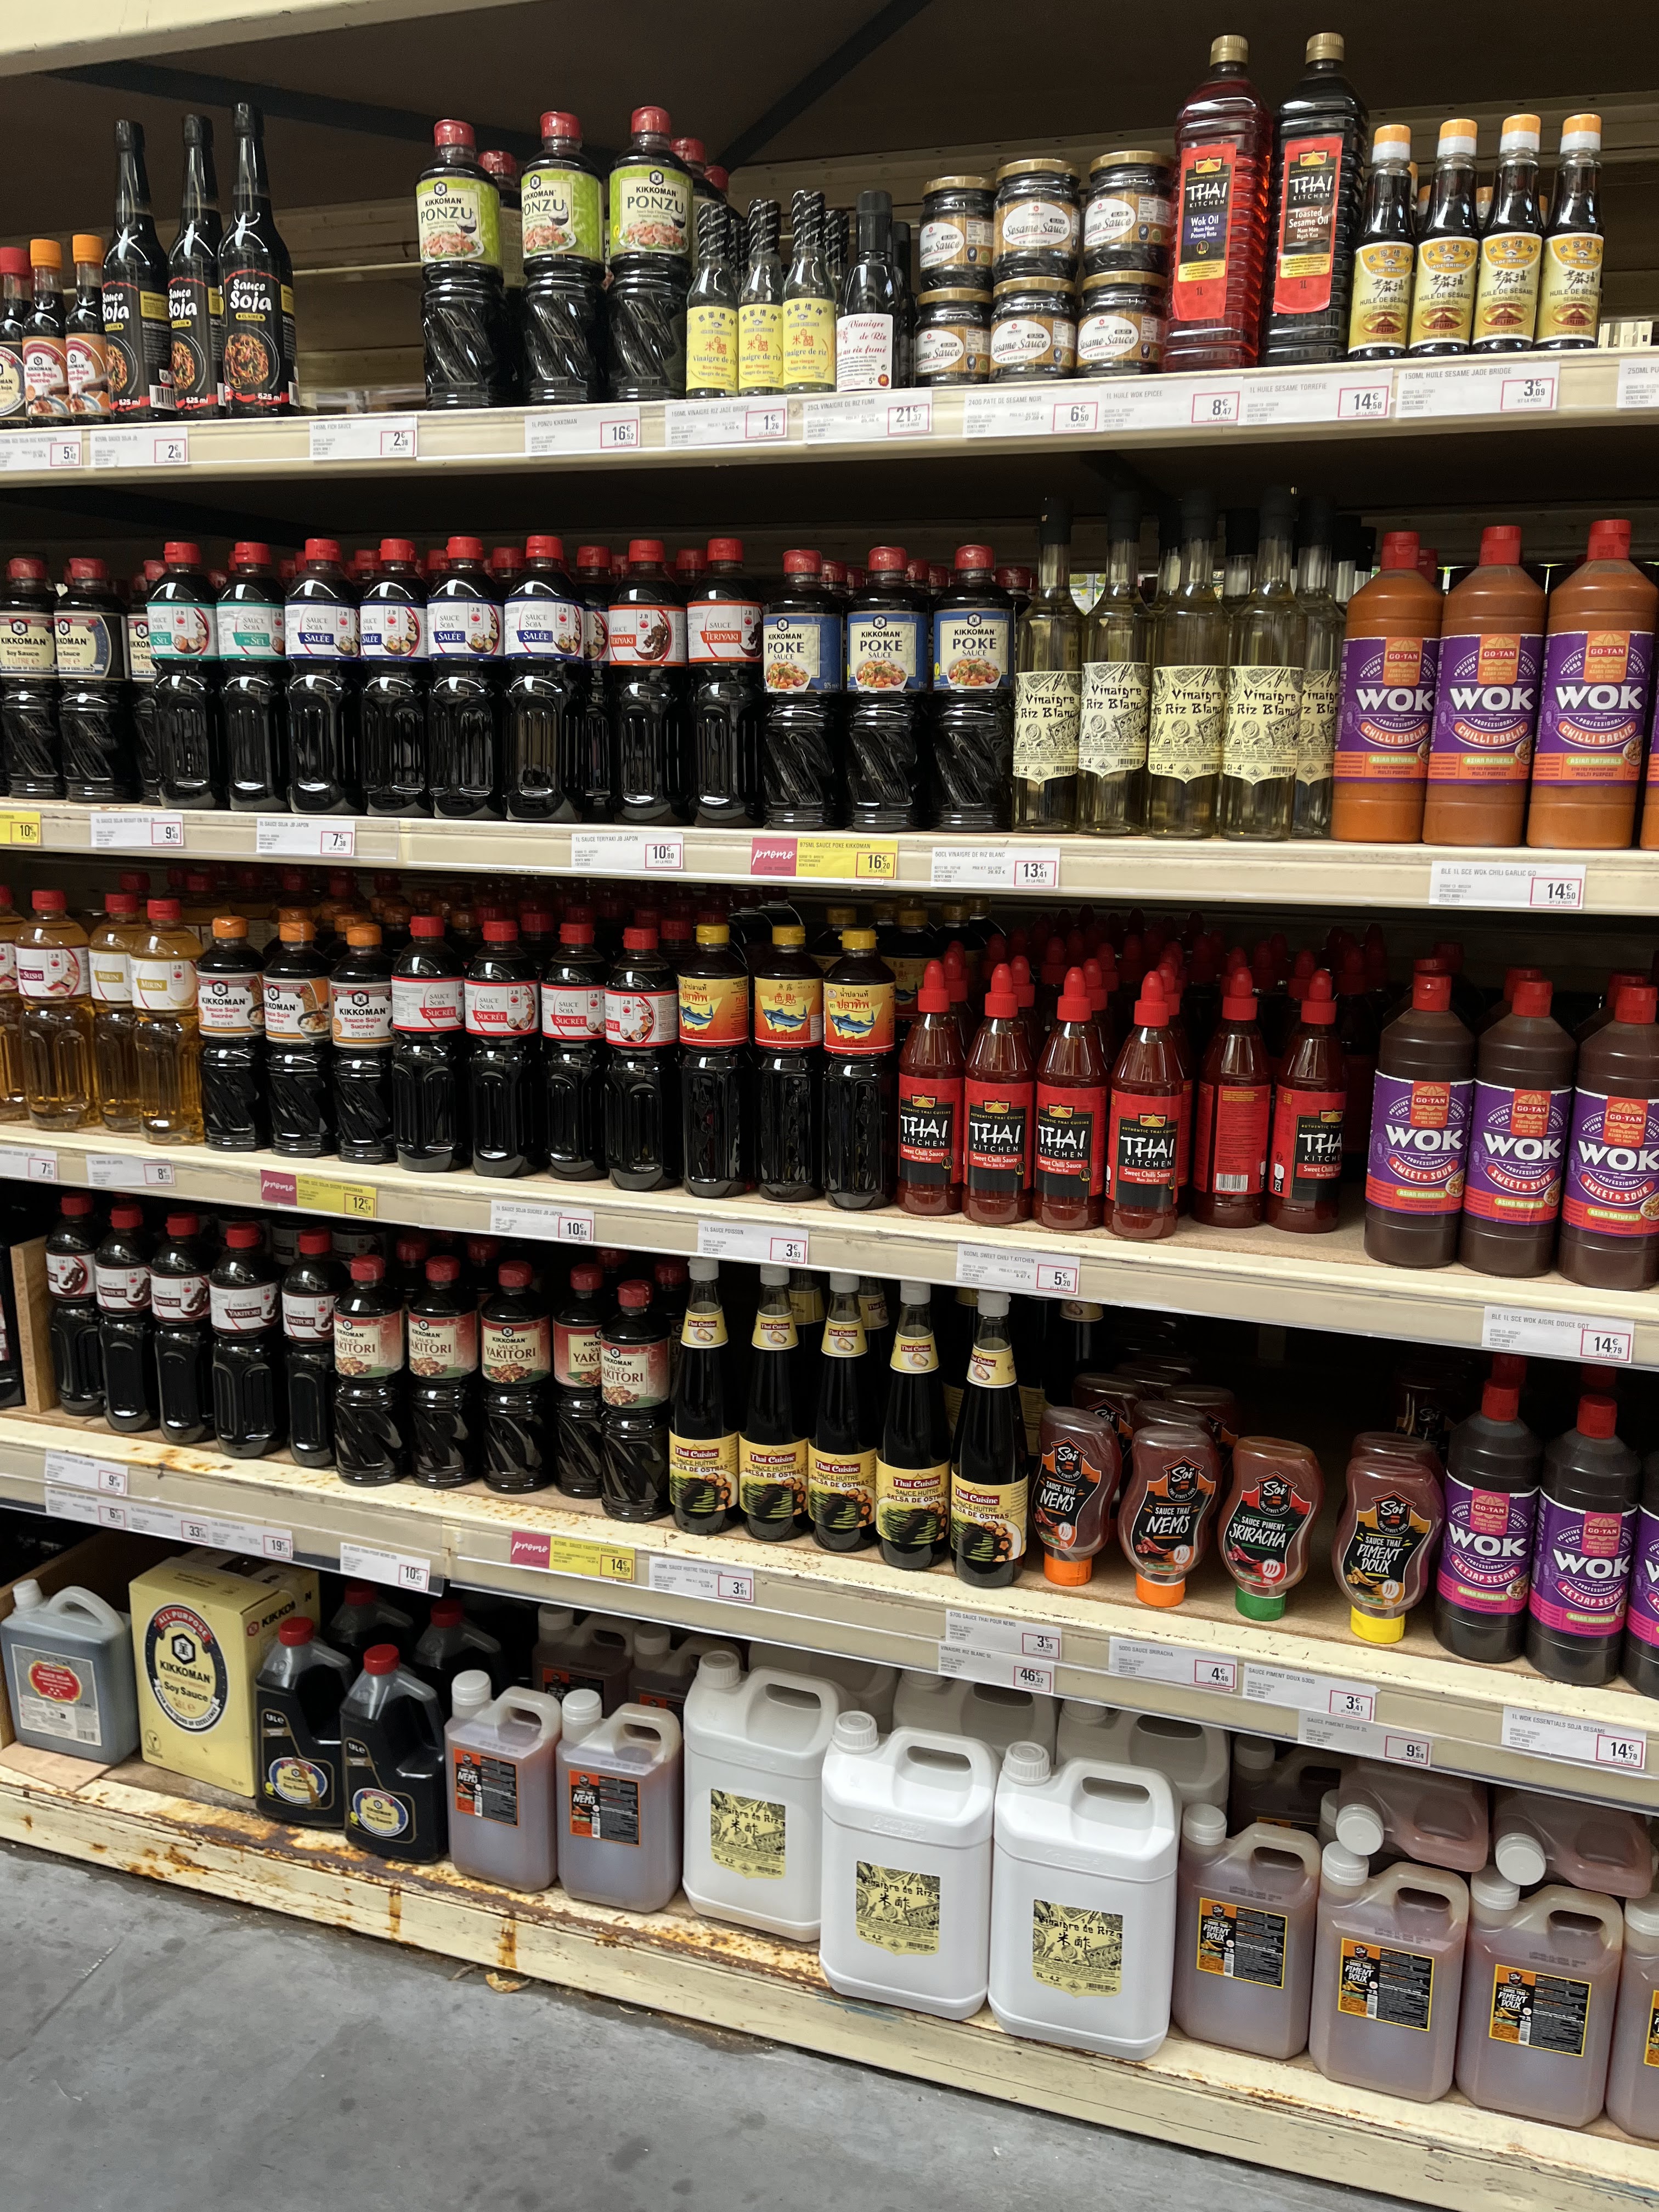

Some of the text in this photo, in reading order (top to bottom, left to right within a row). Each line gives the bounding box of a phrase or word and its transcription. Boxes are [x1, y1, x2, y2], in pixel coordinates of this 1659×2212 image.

[1289, 175, 1333, 193] THAI
[636, 187, 676, 196] KIKKOMAN
[1186, 182, 1227, 201] THAI
[627, 196, 684, 214] PONZU
[1189, 200, 1224, 208] KITCHEN
[421, 207, 473, 223] PONZU
[1295, 207, 1322, 218] Toasted
[1208, 216, 1218, 224] Oil
[1289, 216, 1328, 228] Sesame Oil
[1006, 223, 1068, 237] Sesame Sauce
[233, 279, 266, 291] Sauce
[230, 291, 272, 313] Soja
[1360, 297, 1376, 306] HUILE
[848, 320, 885, 329] Vinaigre
[871, 332, 887, 341] Riz
[305, 633, 330, 642] SALÉE
[706, 632, 738, 641] TERIYAKI
[860, 640, 902, 652] POKE
[953, 638, 996, 650] POKE
[1091, 685, 1141, 698] Vinaigre
[1172, 689, 1221, 703] Vinaigre
[1556, 685, 1643, 710] WOK
[1086, 698, 1140, 709] Riz Blanc
[1356, 688, 1434, 711] WOK
[1449, 687, 1534, 710] WOK
[1364, 726, 1428, 744] CHILLI GARLIC
[753, 848, 795, 866] promo
[477, 1012, 505, 1021] SUCRÉE
[900, 1115, 947, 1138] THAI
[970, 1121, 1021, 1144] THAI
[903, 1136, 945, 1146] KITCHEN
[1385, 1125, 1463, 1151] WOK
[973, 1143, 1018, 1152] KITCHEN
[1483, 1132, 1561, 1160] WOK
[1125, 1169, 1138, 1177] Sweet
[1393, 1160, 1453, 1180] SWEET SOUR
[486, 1346, 536, 1359] YAKITORI
[676, 1446, 718, 1458] Thai Cuisine
[1040, 1491, 1075, 1512] NEMS
[1147, 1516, 1190, 1534] NEMS
[1242, 1516, 1285, 1531] SAUCE PIMENT
[1229, 1523, 1286, 1548] SRIRACHA
[1448, 1522, 1527, 1557] WOK
[511, 1540, 549, 1555] promo
[1357, 1544, 1404, 1561] PIMENT
[1361, 1558, 1392, 1575] DOUX
[1553, 1549, 1630, 1579] WOK
[1149, 1649, 1173, 1657] SRIRACHA
[160, 1660, 211, 1684] KIKKOMAN
[1266, 1671, 1285, 1679] PIMENT
[164, 1681, 208, 1703] Soy Sauce
[1533, 1717, 1566, 1729] ESSENTIALS
[1584, 1725, 1606, 1735] SESAME
[458, 1771, 478, 1784] NEMS
[573, 1793, 595, 1805] NEMS
[902, 1886, 913, 1894] de
[916, 1887, 932, 1898] Riz
[1204, 1923, 1230, 1937] PIMENT
[1207, 1932, 1224, 1942] DOUX
[1346, 1965, 1374, 1978] PIMENT
[1348, 1972, 1367, 1984] DOUX
[1498, 1991, 1528, 2004] PIMENT
[1501, 2000, 1521, 2010] DOUX
